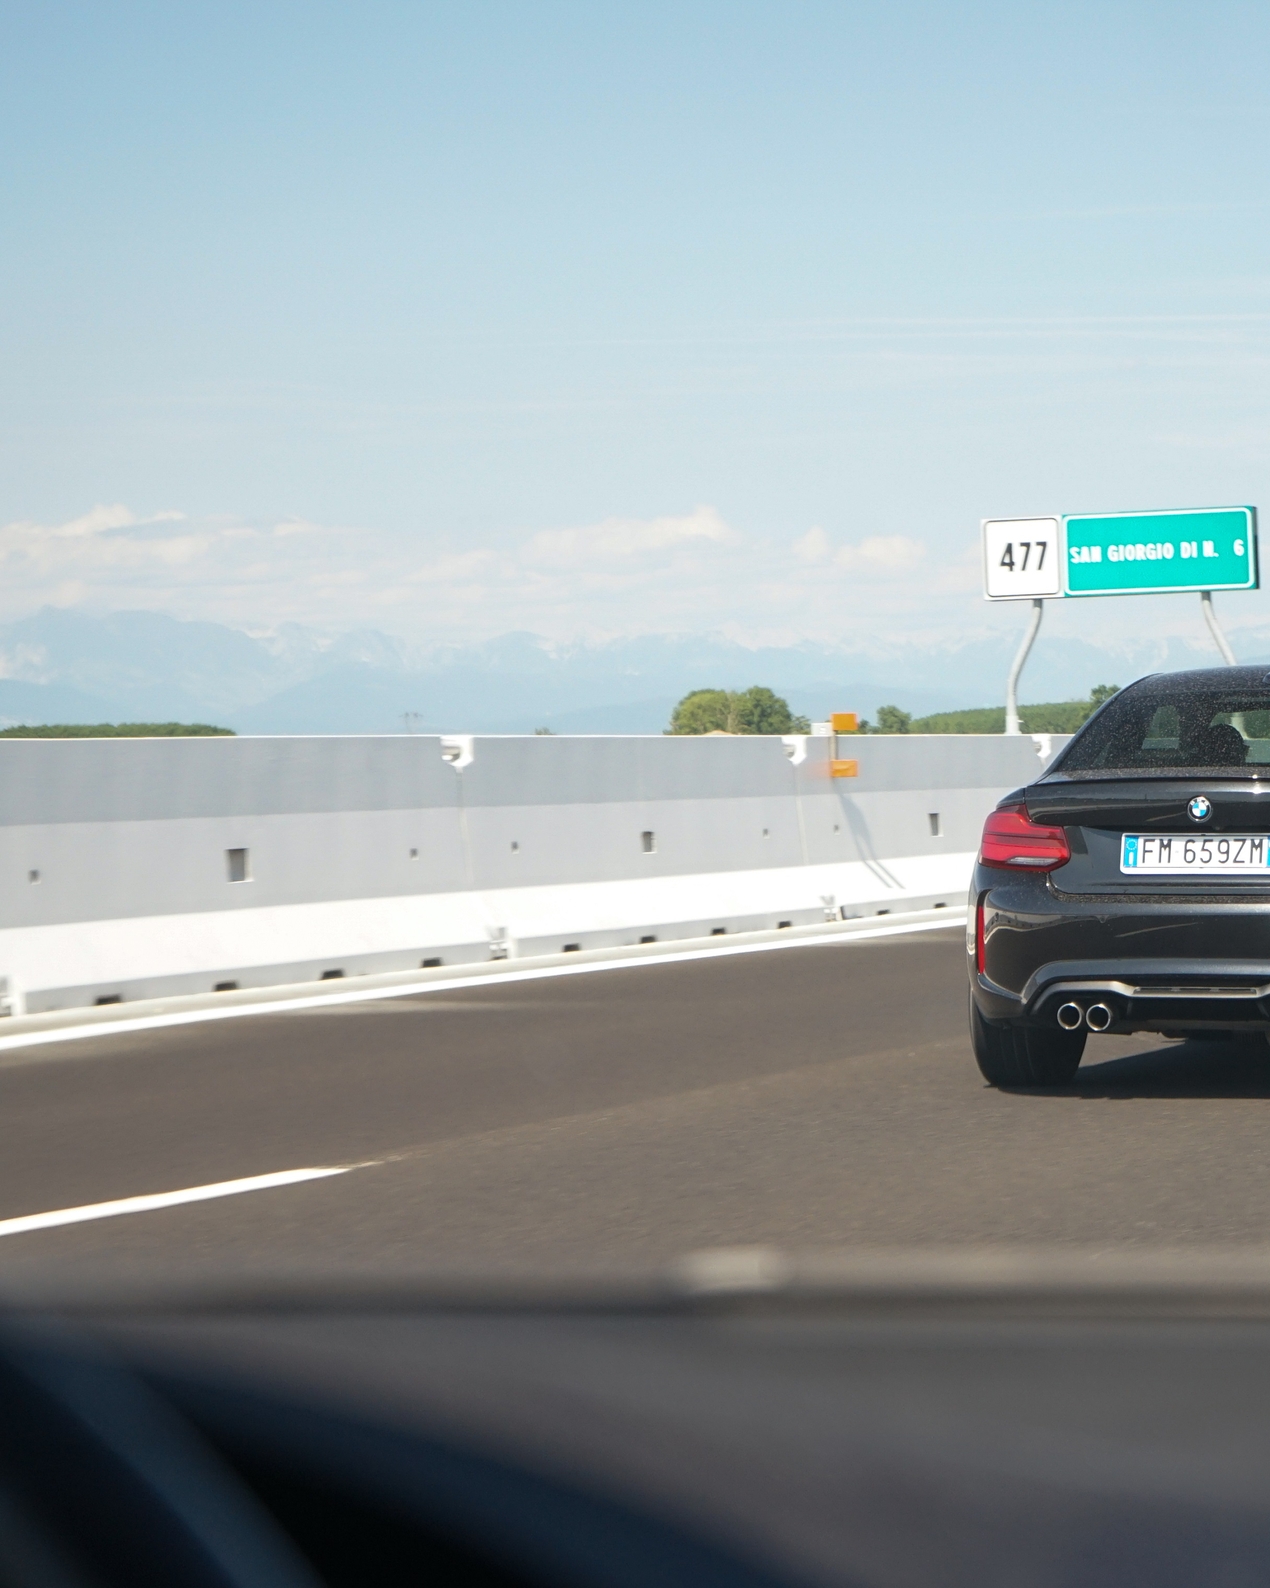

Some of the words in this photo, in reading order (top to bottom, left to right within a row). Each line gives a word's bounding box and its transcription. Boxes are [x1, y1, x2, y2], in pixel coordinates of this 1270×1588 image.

[1000, 541, 1047, 572] 477
[1069, 545, 1103, 564] SAN
[1107, 541, 1175, 563] GIORGIO
[1180, 540, 1198, 559] DI
[1233, 538, 1245, 556] 6
[1142, 838, 1172, 864] FM
[1183, 838, 1264, 864] 659ZM
